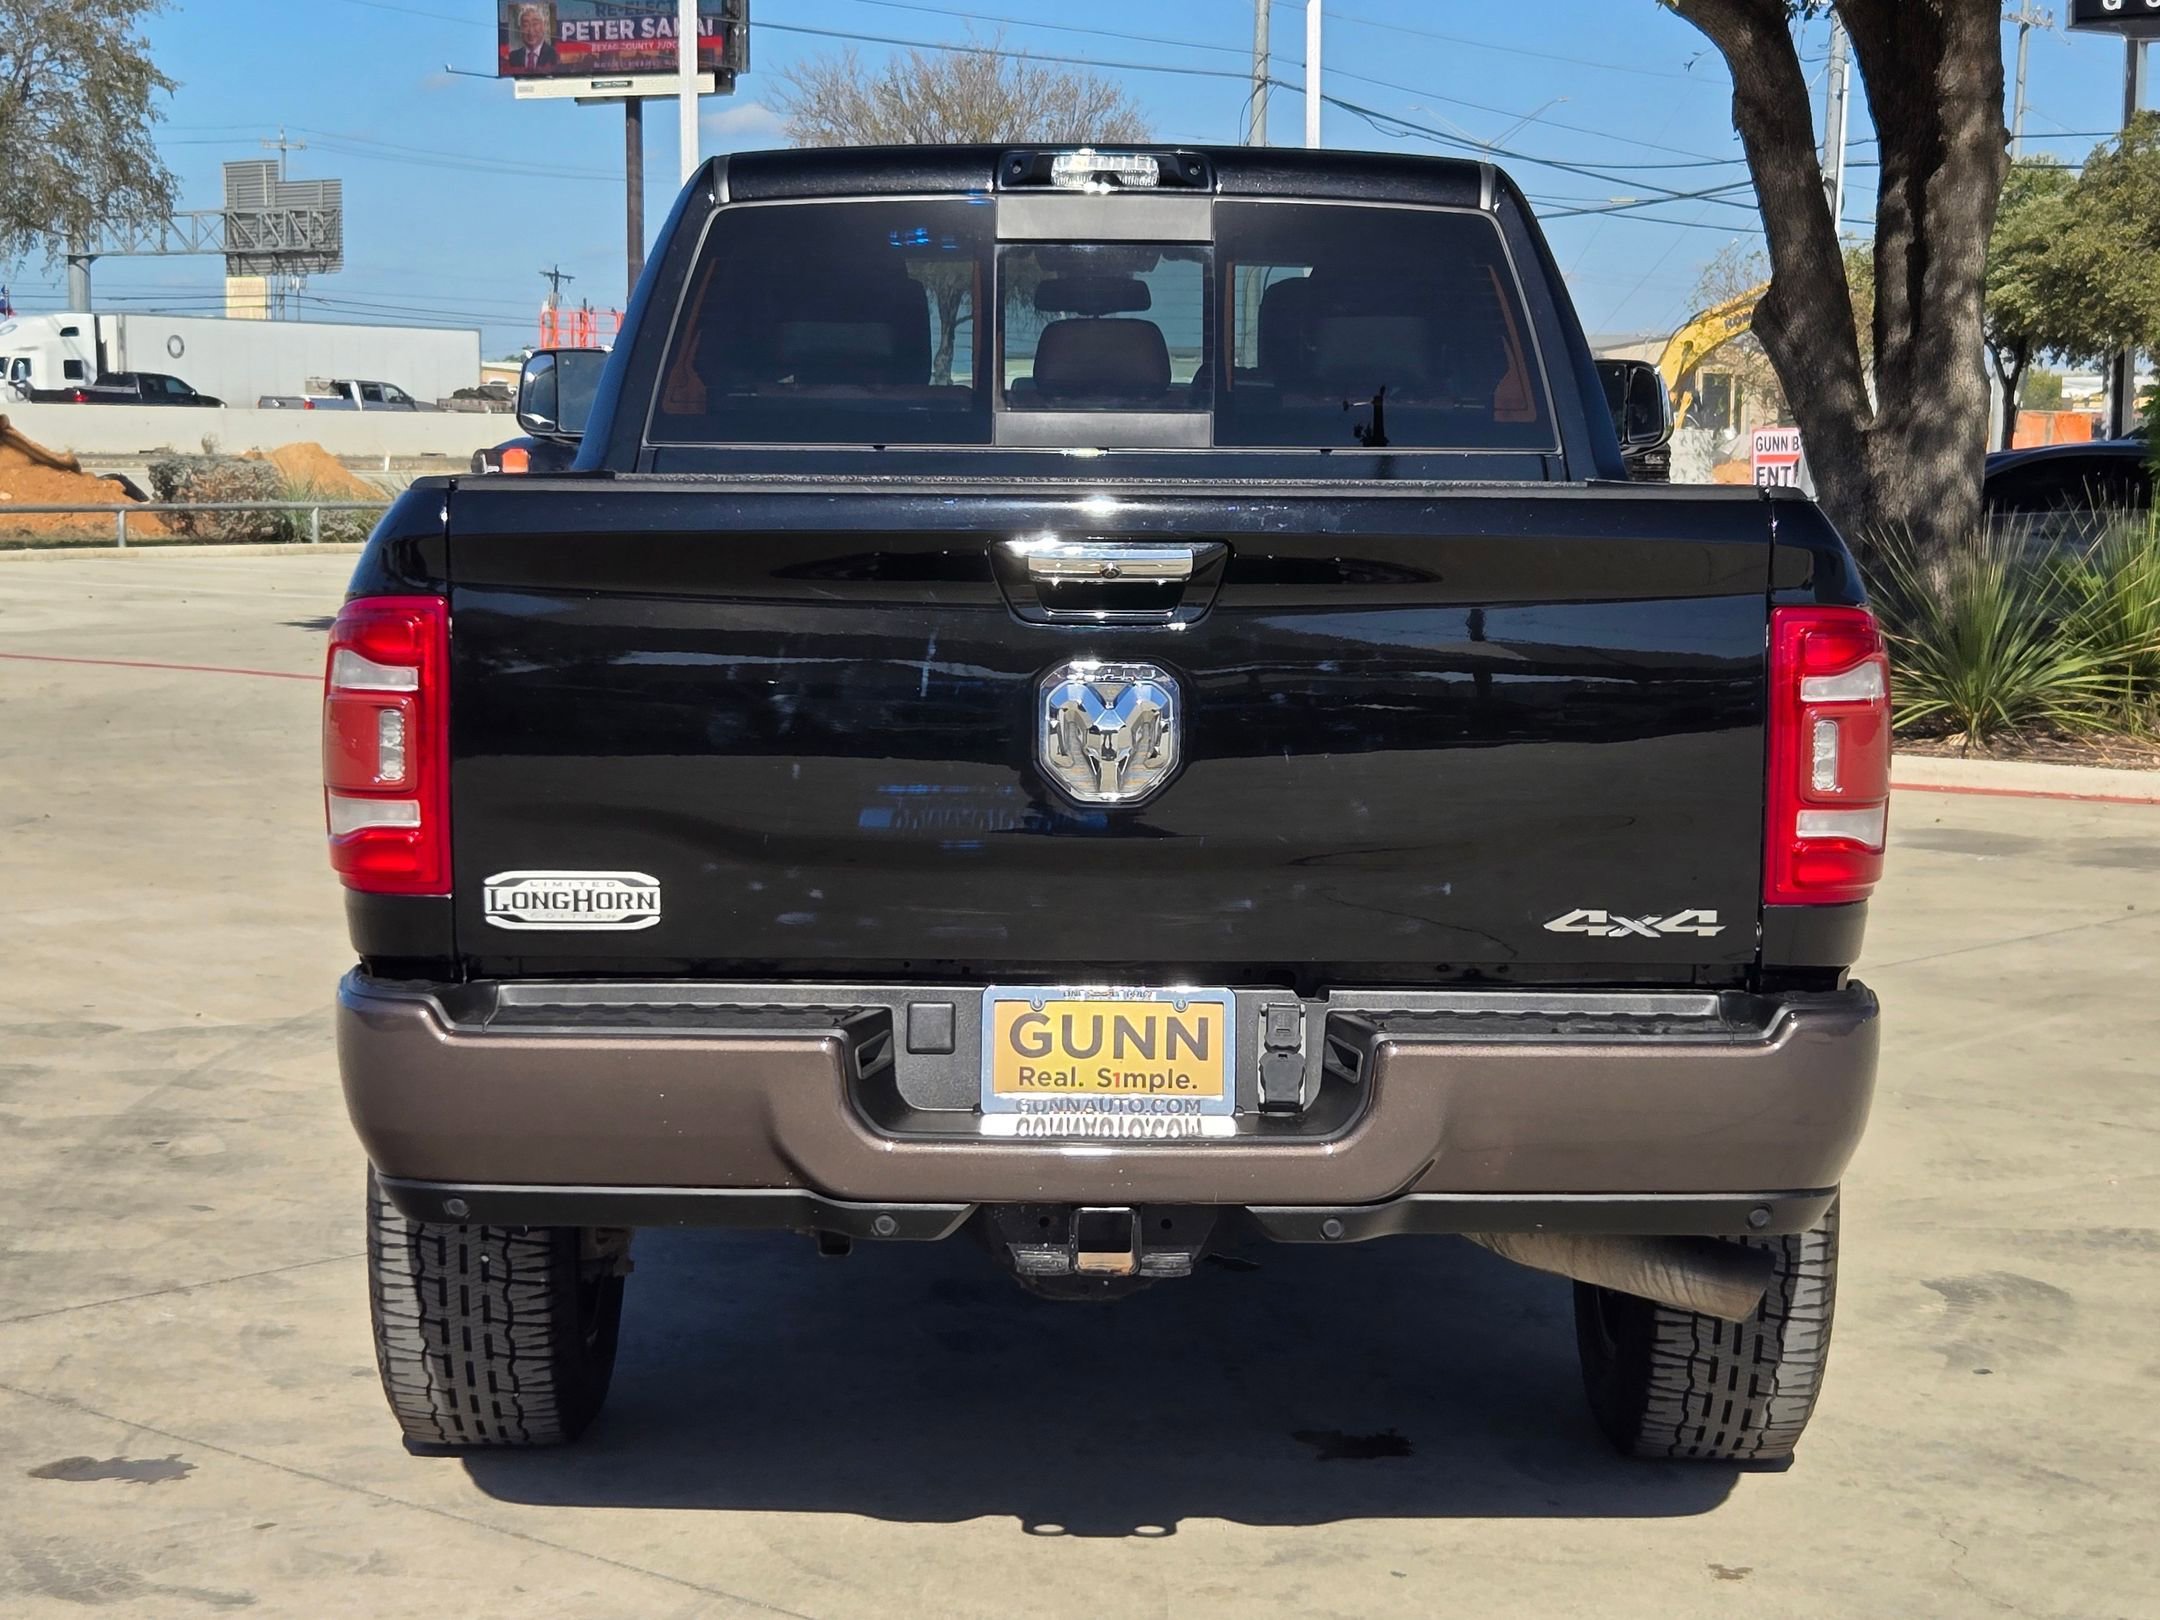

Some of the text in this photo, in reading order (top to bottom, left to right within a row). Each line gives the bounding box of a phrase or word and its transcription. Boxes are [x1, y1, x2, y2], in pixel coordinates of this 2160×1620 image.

[562, 17, 713, 41] PETER SAAI
[1755, 435, 1800, 452] GUNN B
[1009, 1012, 1209, 1061] GUNN
[1018, 1066, 1085, 1088] Real.
[1015, 1098, 1201, 1114] GUNNAUTO.COM
